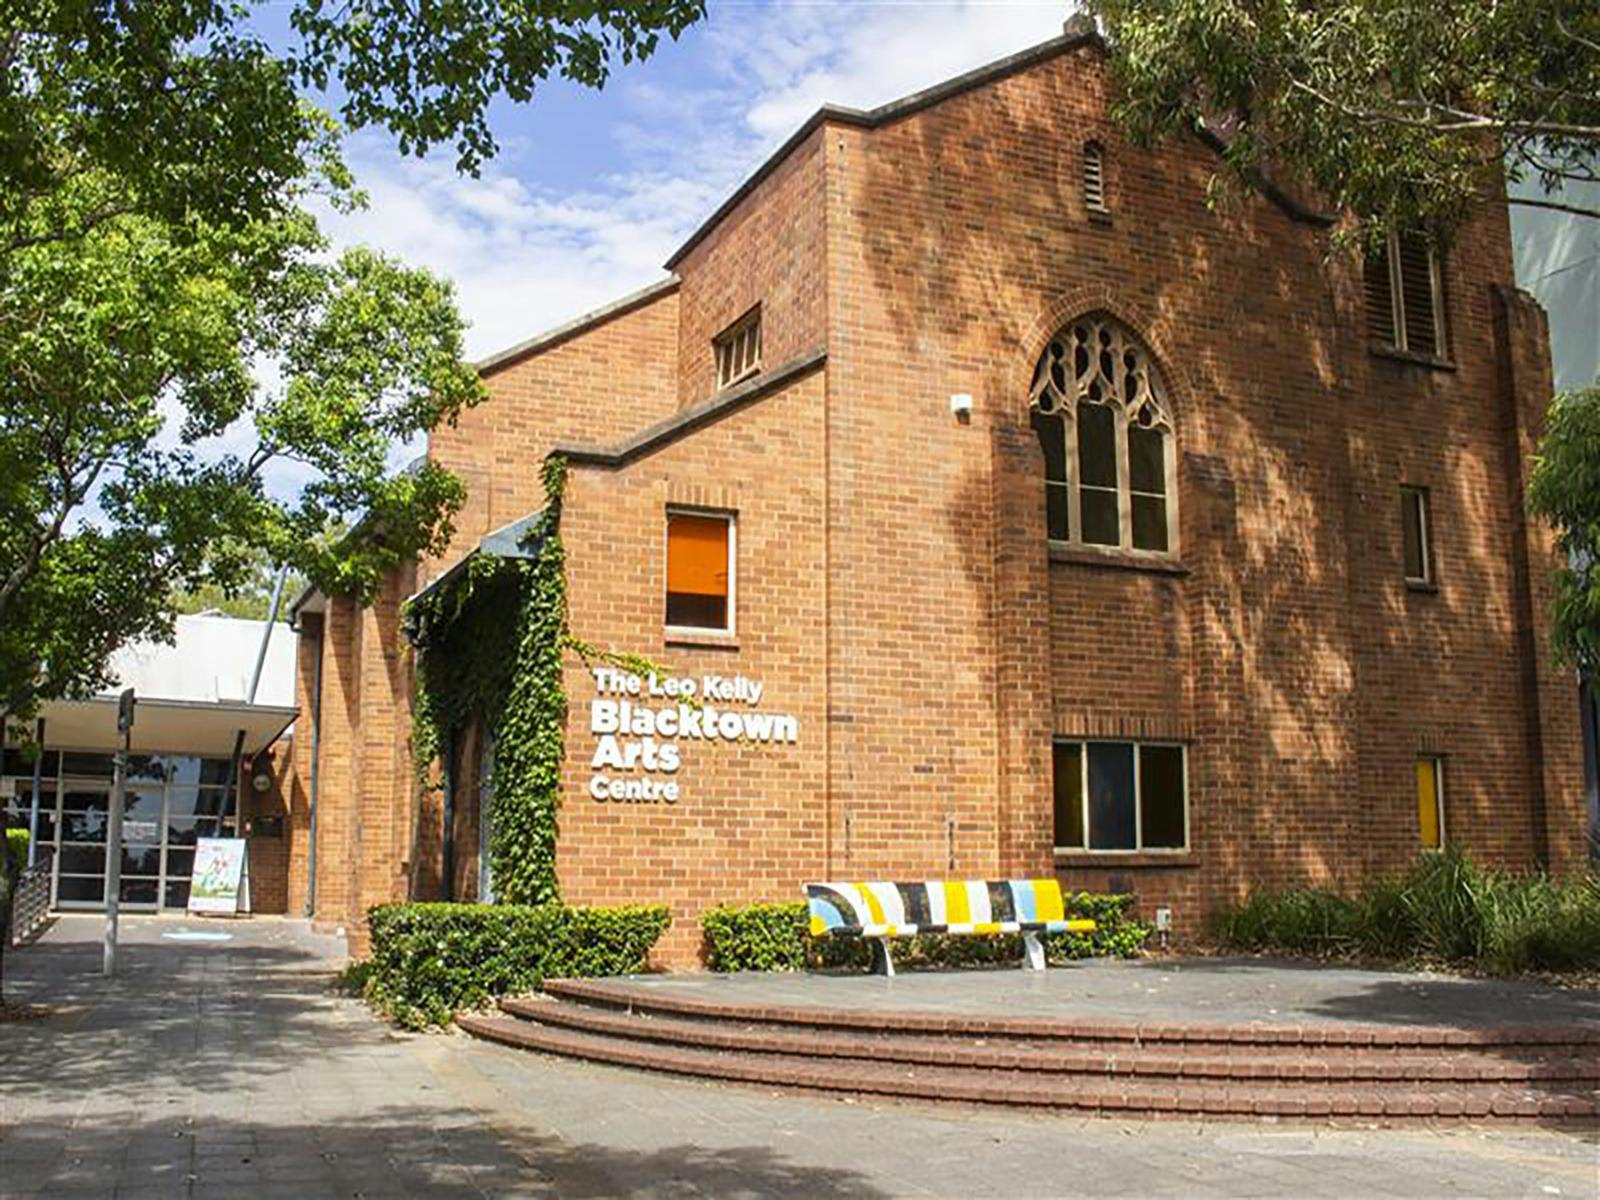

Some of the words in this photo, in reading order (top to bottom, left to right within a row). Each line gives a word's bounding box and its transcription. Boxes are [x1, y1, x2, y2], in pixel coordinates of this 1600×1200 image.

[593, 668, 640, 694] The
[649, 672, 696, 697] Leo
[703, 674, 762, 705] Kelly
[591, 699, 798, 742] Blacktown
[591, 736, 680, 772] Arts
[590, 775, 679, 801] Centre
